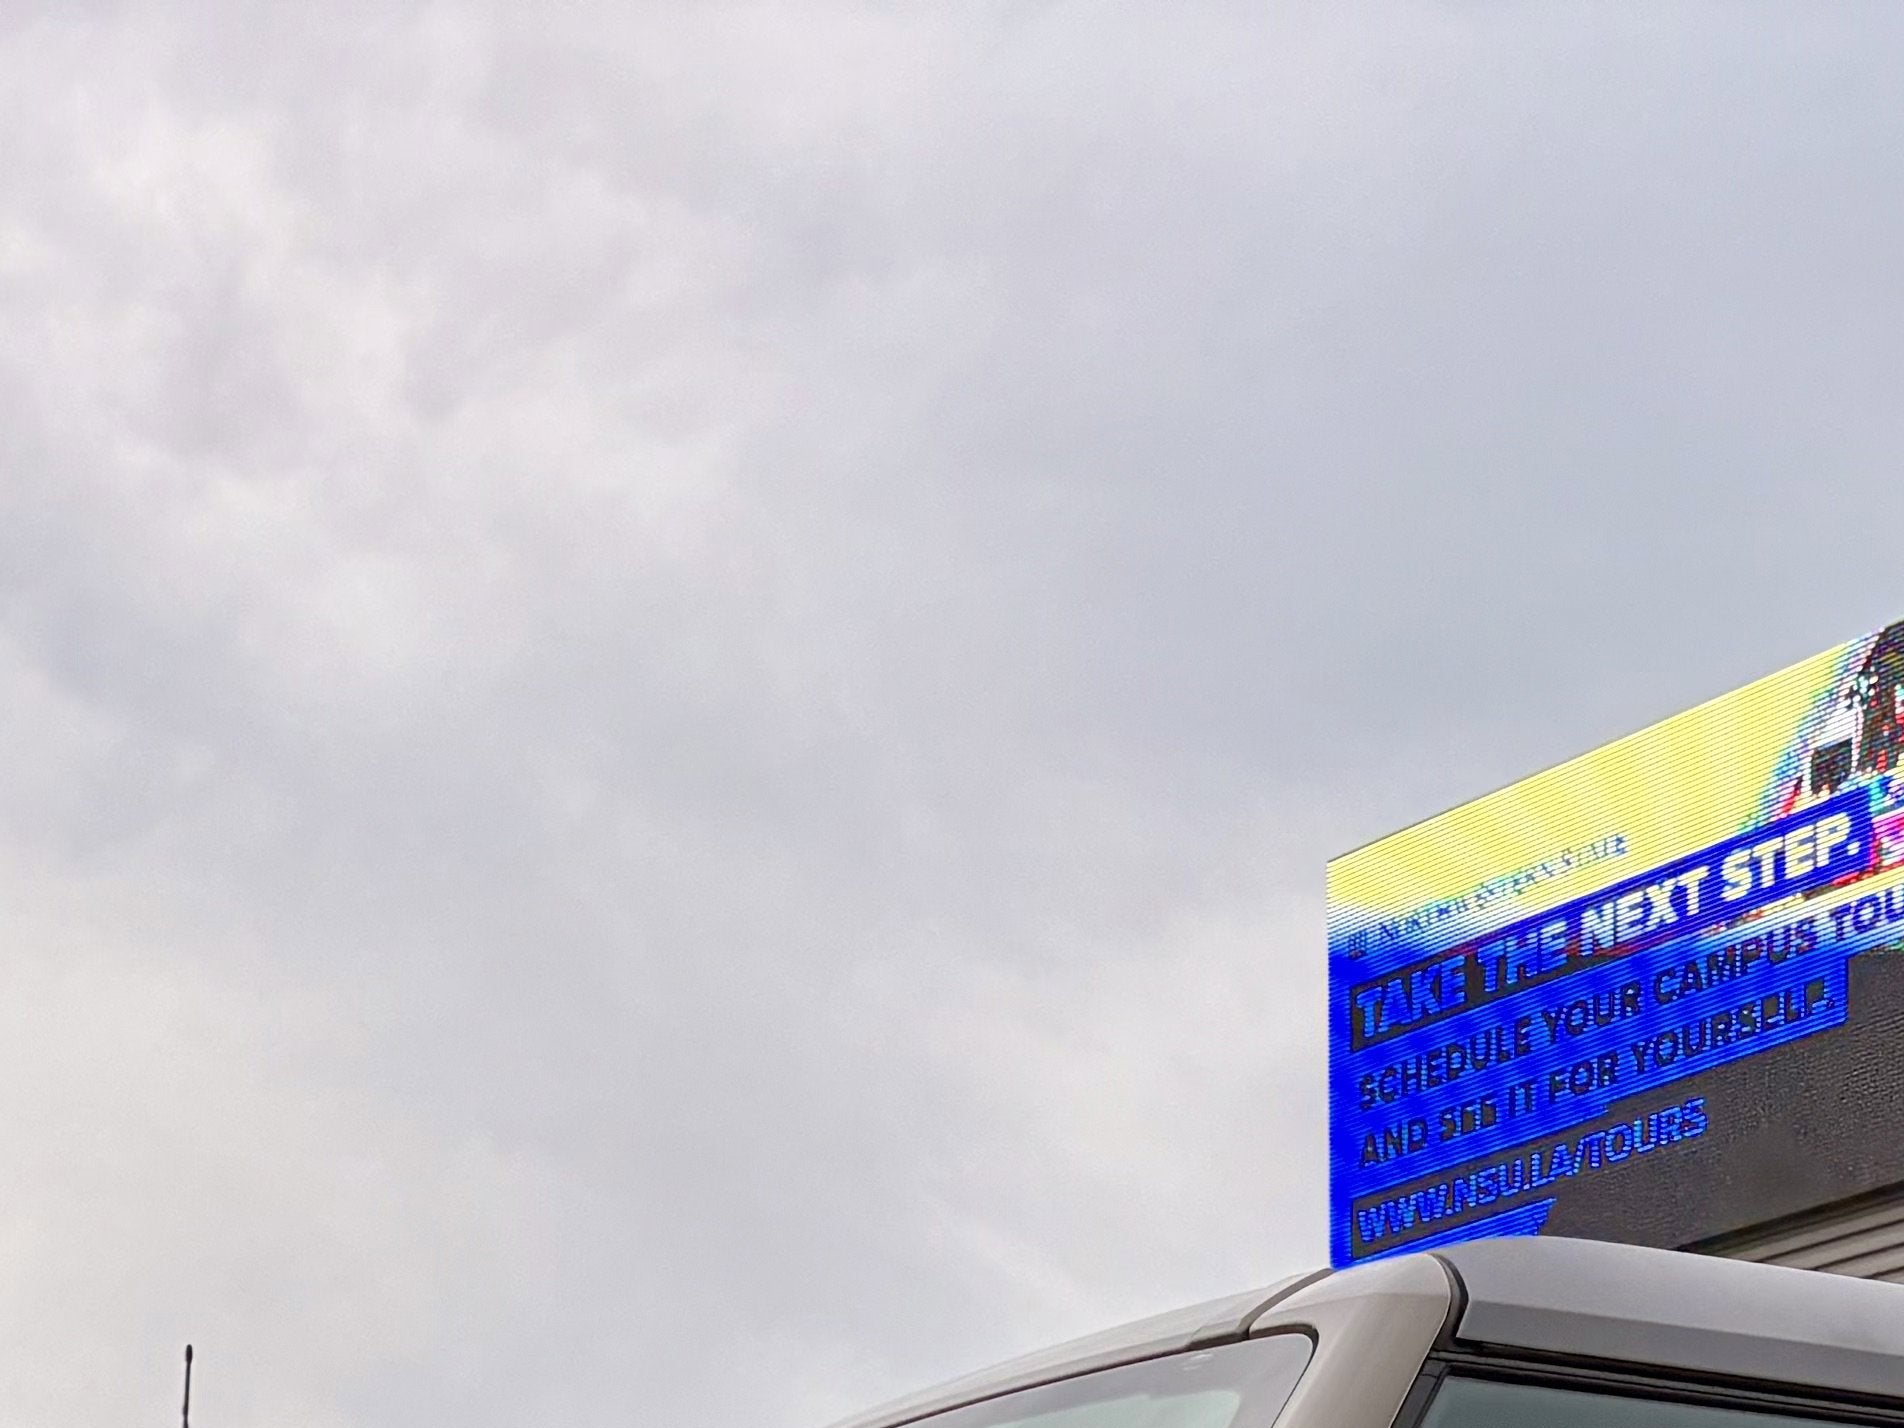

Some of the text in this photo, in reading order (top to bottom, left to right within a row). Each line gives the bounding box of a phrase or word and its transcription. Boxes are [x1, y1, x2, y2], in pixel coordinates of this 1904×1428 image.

[1355, 811, 1862, 1038] TAKE THE NEXT STEP.
[1360, 1014, 1532, 1111] SCHEDULE
[1542, 981, 1641, 1044] YOUR
[1653, 914, 1819, 1002] CAMPUS
[1356, 1096, 1710, 1243] WWW.NSU.LA/TOURS
[1360, 1119, 1429, 1168] AND
[1507, 1078, 1537, 1119] IT
[1548, 1052, 1619, 1103] FOR
